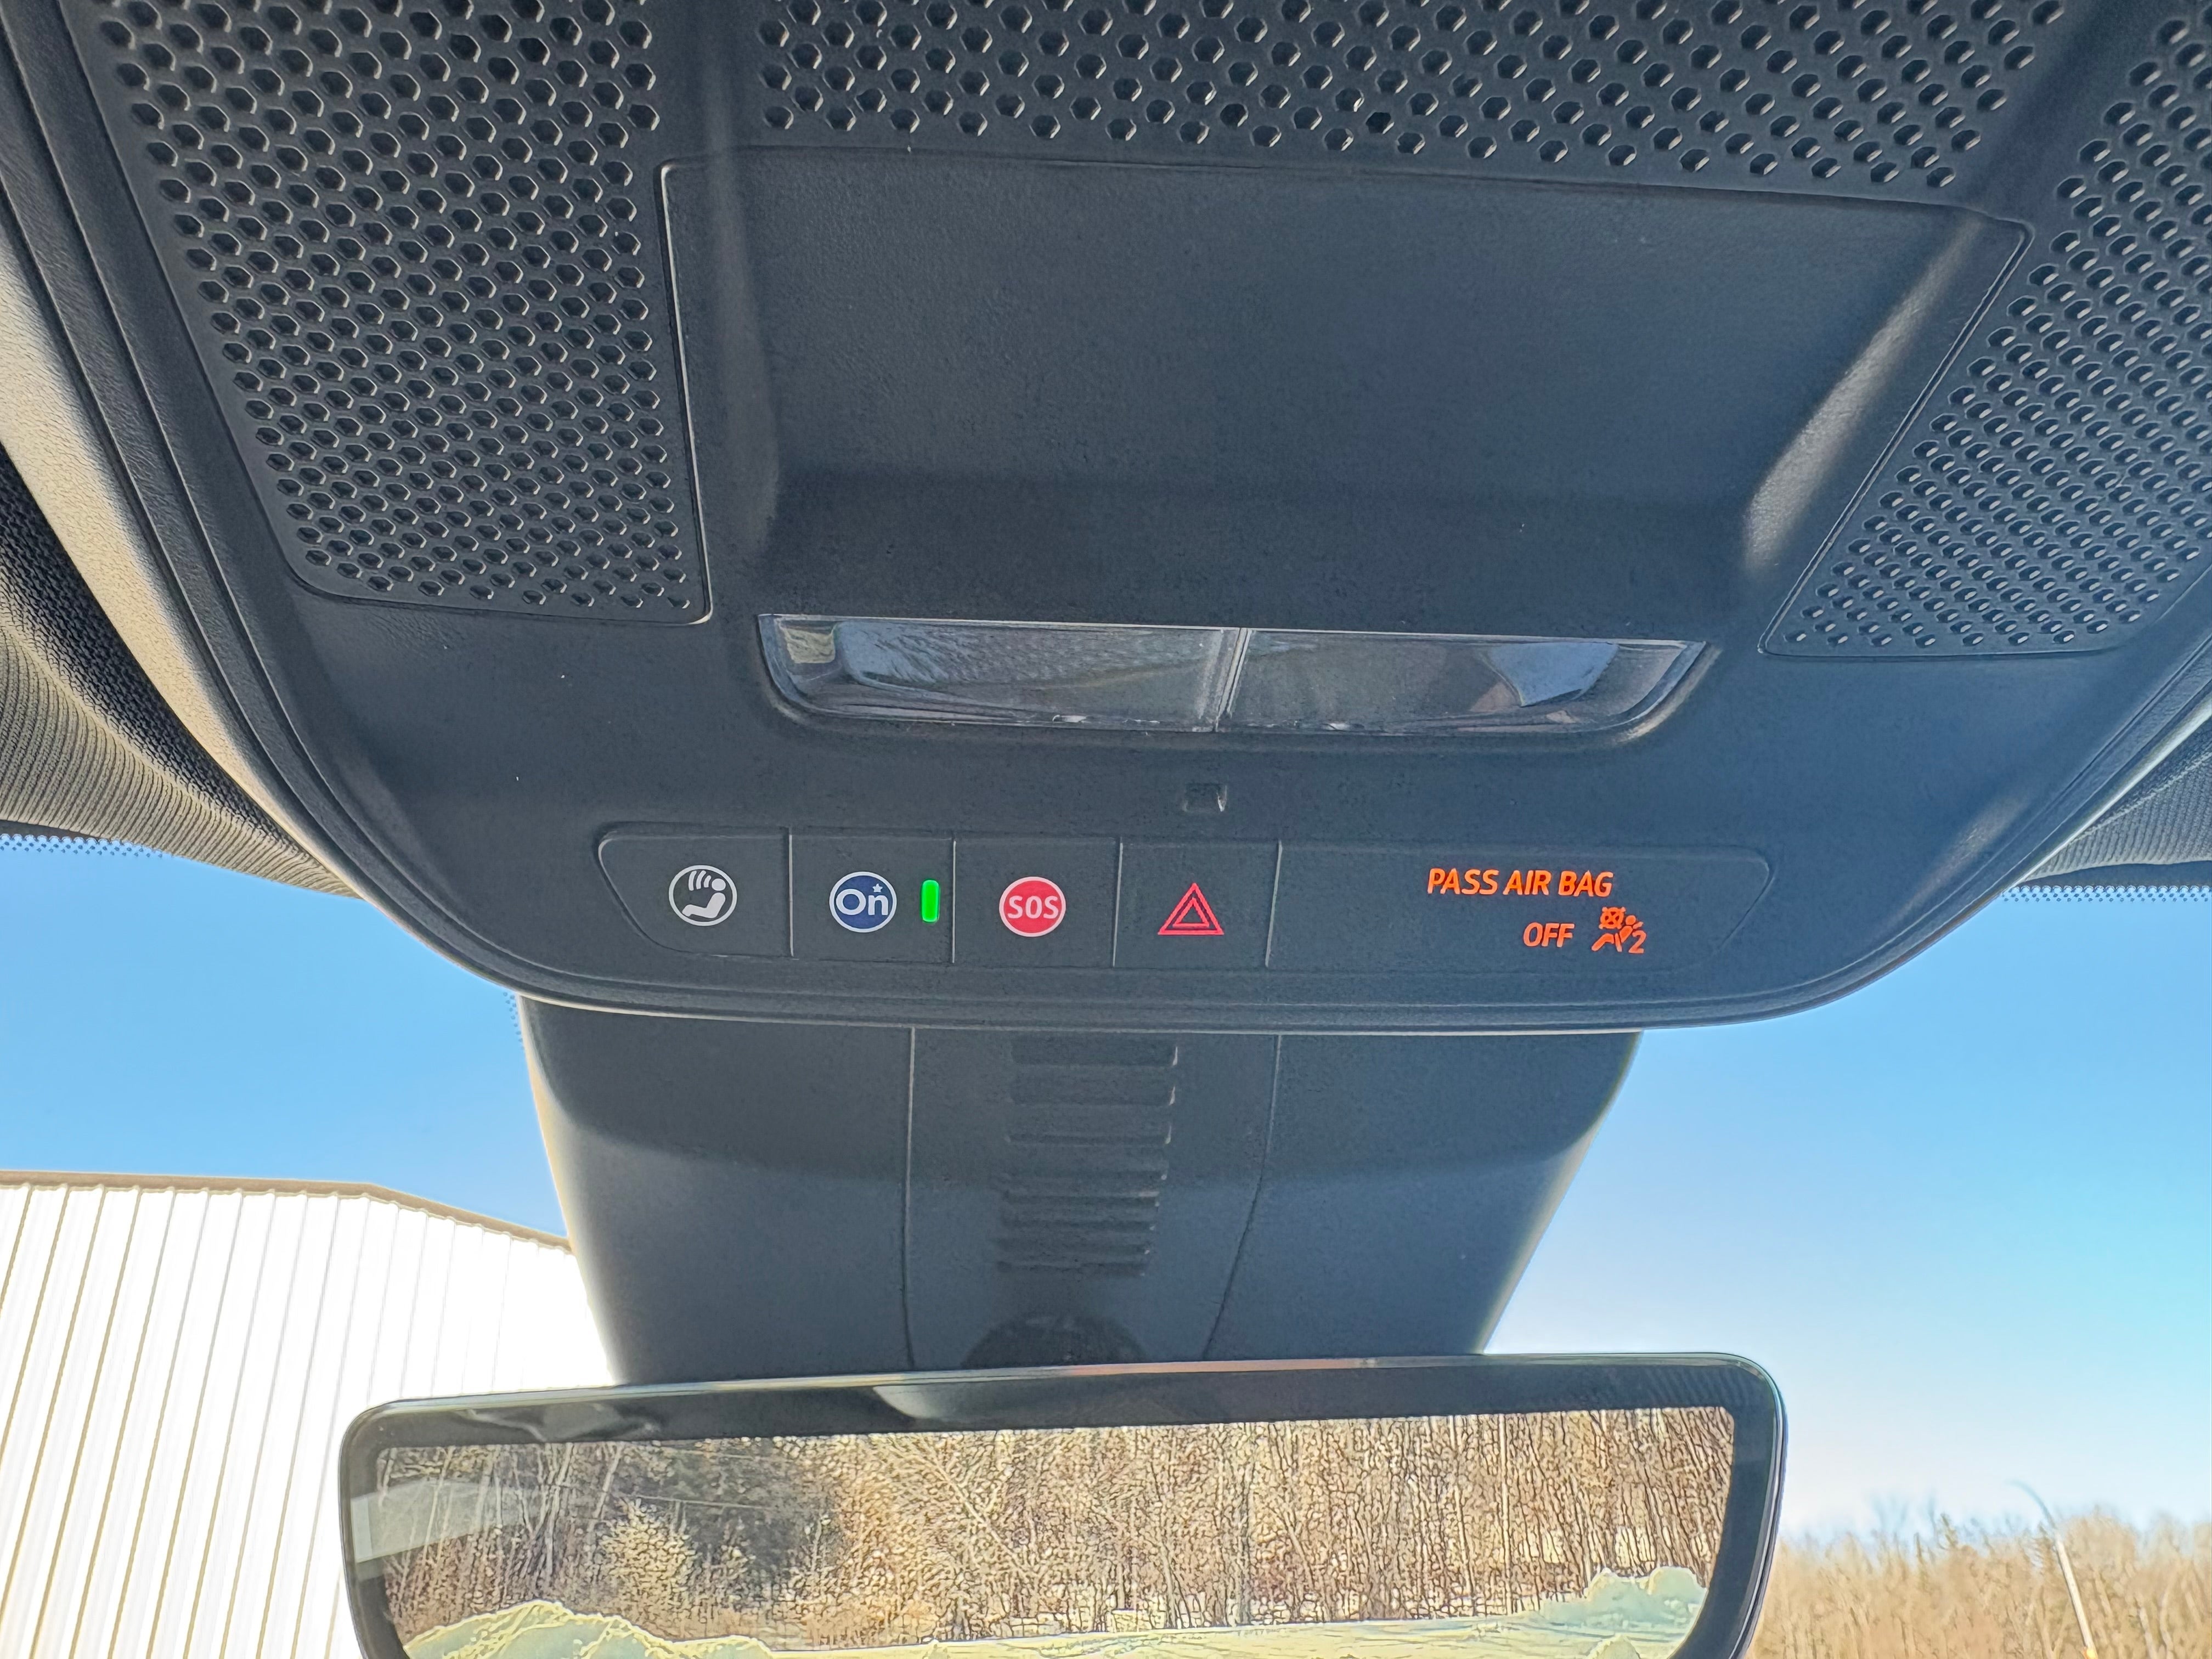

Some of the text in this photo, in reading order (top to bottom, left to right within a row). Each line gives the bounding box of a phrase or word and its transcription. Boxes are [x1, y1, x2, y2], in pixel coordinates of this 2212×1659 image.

[1427, 867, 1614, 898] PASS AIR BAG
[836, 888, 889, 916] On
[1007, 895, 1059, 919] SOS
[1523, 922, 1647, 954] OFF 2
